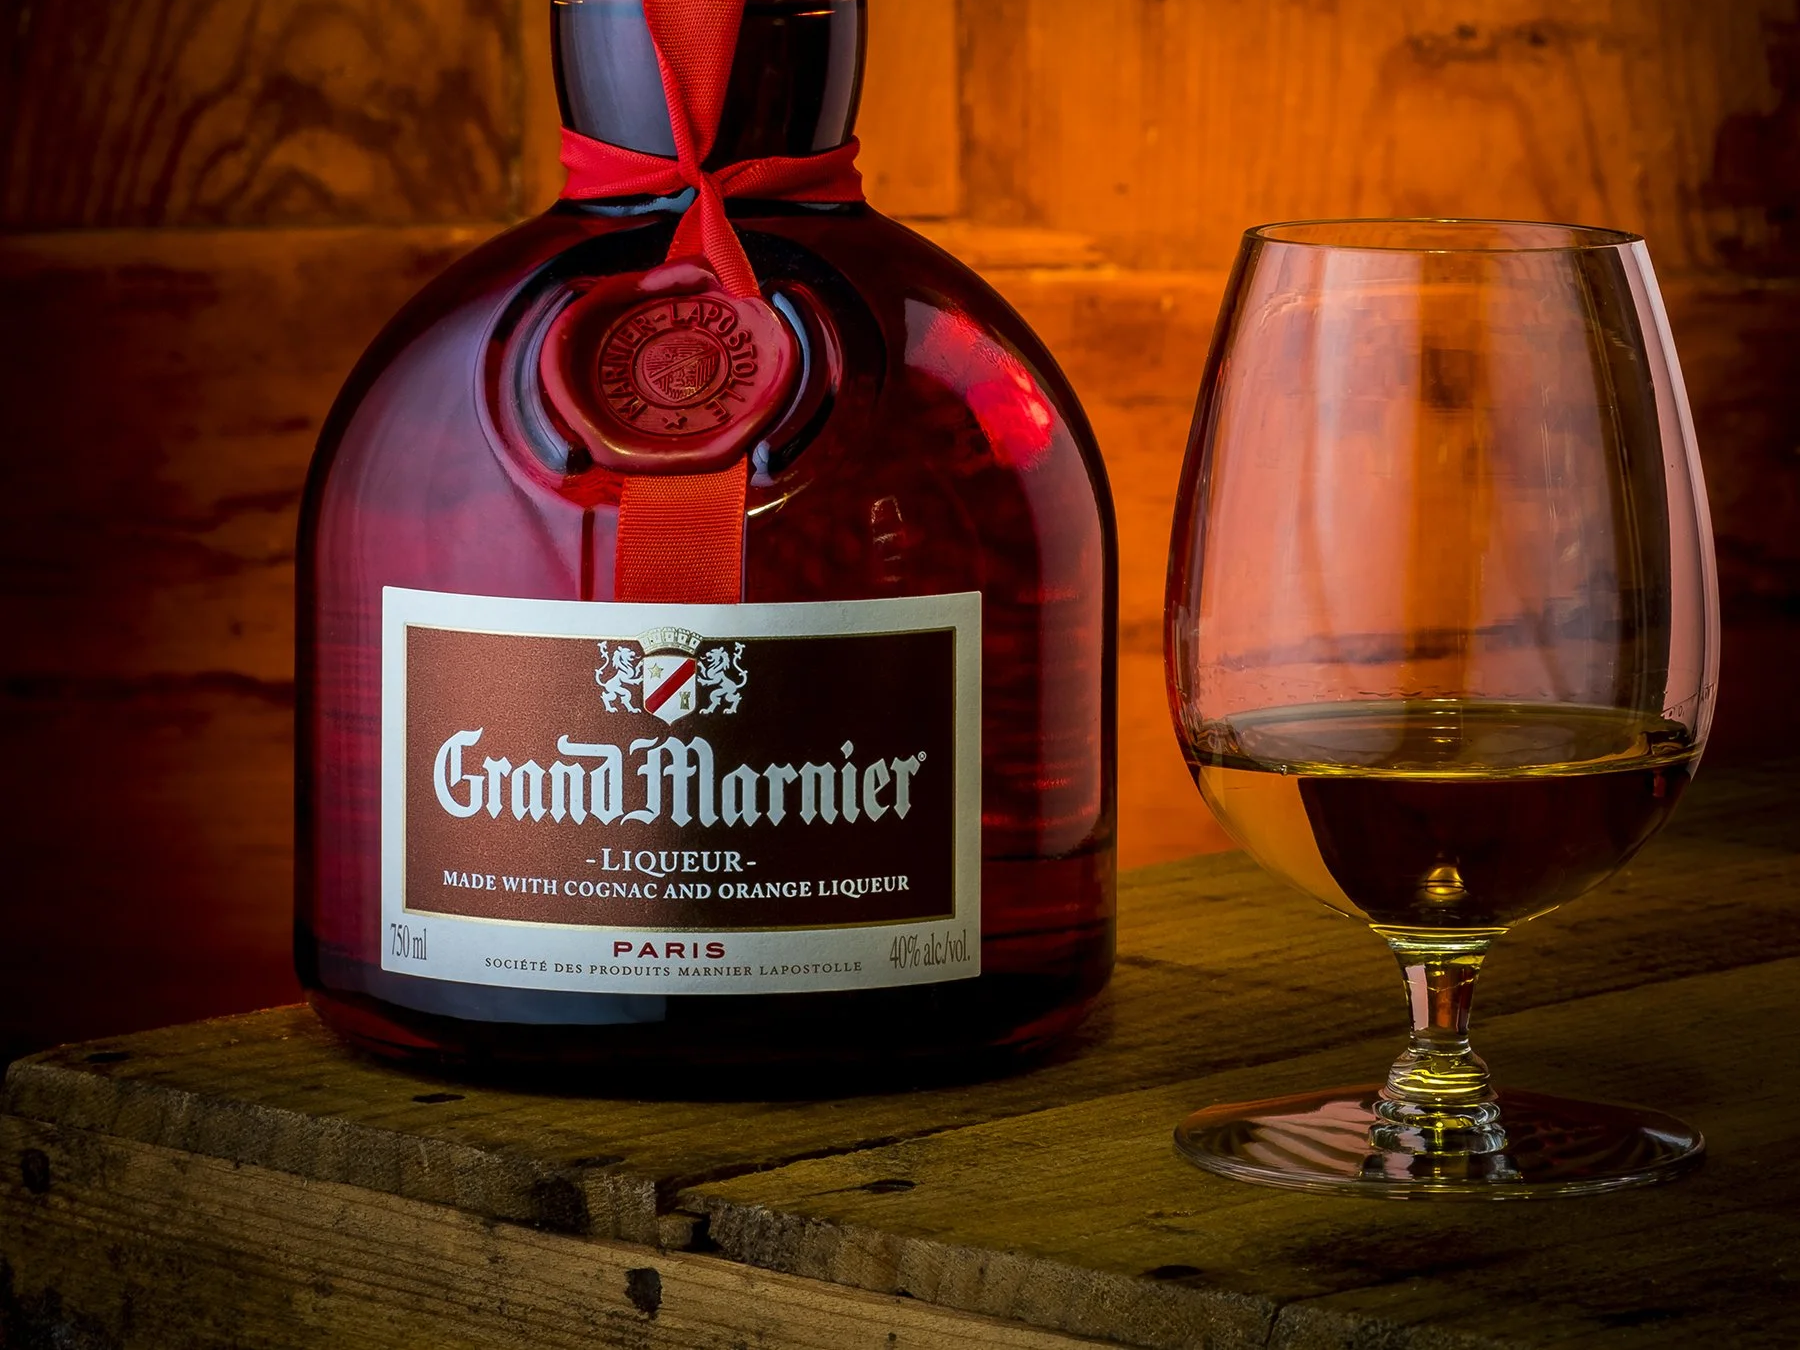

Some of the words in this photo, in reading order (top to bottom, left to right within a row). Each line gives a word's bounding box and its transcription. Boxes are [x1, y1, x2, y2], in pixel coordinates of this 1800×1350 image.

[433, 727, 624, 826] Grand
[442, 869, 497, 892] MADE
[502, 876, 558, 897] WITH
[563, 880, 658, 899] COGNAC
[662, 882, 713, 900] AND
[718, 881, 813, 900] ORANGE
[818, 874, 911, 900] LIQUEUR
[390, 923, 411, 959] 750
[412, 928, 428, 961] ml
[613, 941, 726, 960] PARIS
[889, 934, 922, 969] 40%
[484, 956, 548, 973] SOCIÉTÉ
[554, 963, 583, 975] DES
[589, 965, 671, 978] PRODUITS
[677, 965, 753, 978] MARNIER
[759, 961, 863, 977] LAPOSTOLLE
